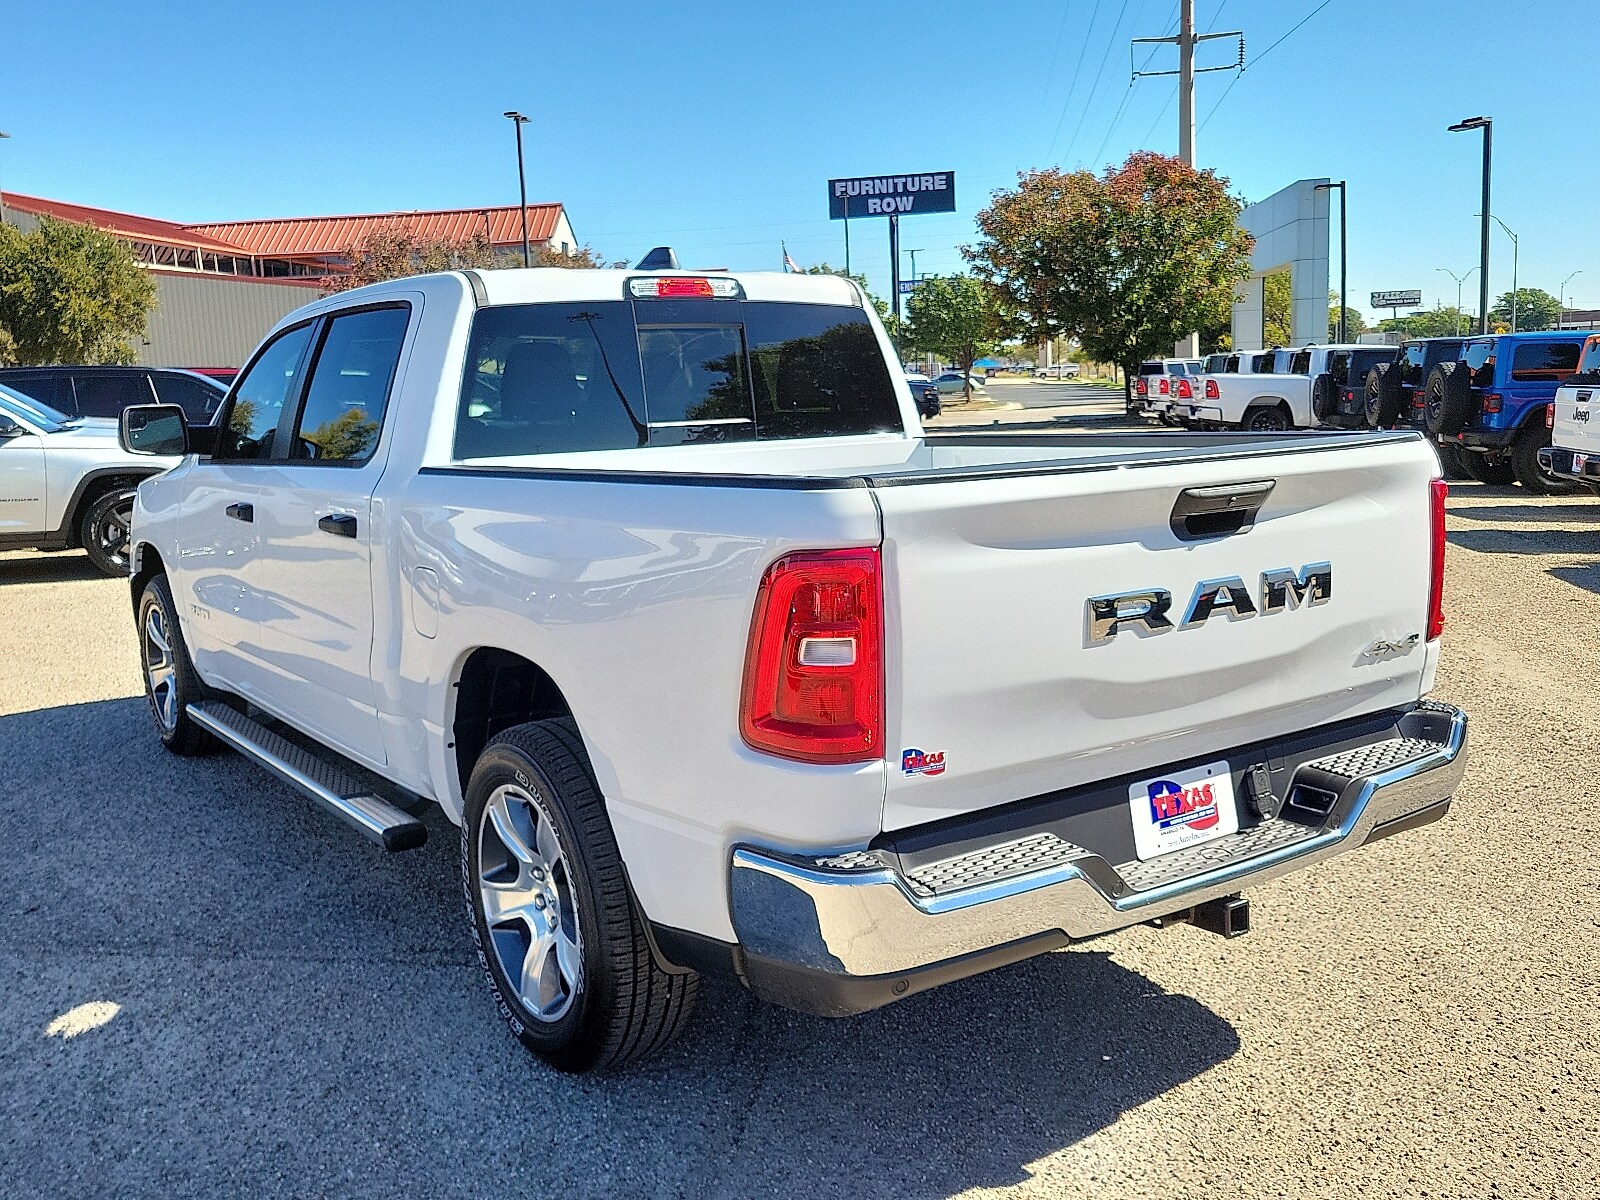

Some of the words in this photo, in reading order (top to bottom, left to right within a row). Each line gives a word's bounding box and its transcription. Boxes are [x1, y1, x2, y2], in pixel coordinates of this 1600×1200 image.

[834, 175, 948, 197] FURNITURE
[868, 196, 914, 214] ROW
[1572, 406, 1590, 425] Jeep
[1082, 561, 1332, 649] RAM
[903, 751, 945, 769] TEXAS
[1152, 783, 1214, 820] TEXAS
